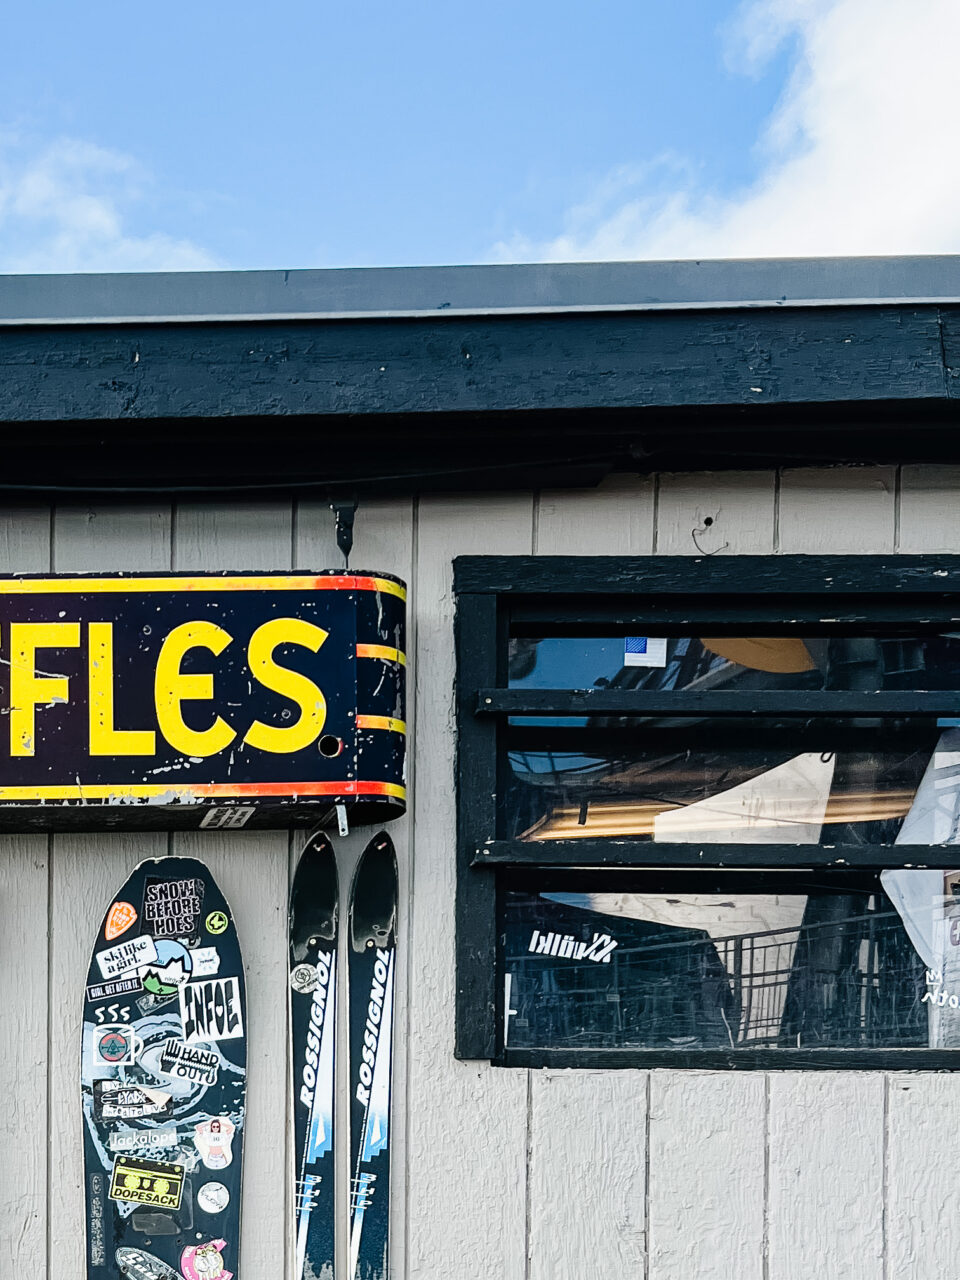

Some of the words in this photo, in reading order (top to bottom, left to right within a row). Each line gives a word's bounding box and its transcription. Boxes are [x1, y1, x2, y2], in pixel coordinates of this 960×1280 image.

[147, 880, 195, 902] SNOW
[145, 896, 201, 920] BEFORE
[154, 915, 194, 936] HOES
[104, 948, 125, 963] ski
[123, 941, 147, 956] like
[107, 965, 116, 974] a
[355, 948, 390, 1108] ROSSIGNOL
[181, 1047, 219, 1065] HAND
[112, 1130, 177, 1146] Jackalope
[113, 1187, 178, 1207] DOPESACK
